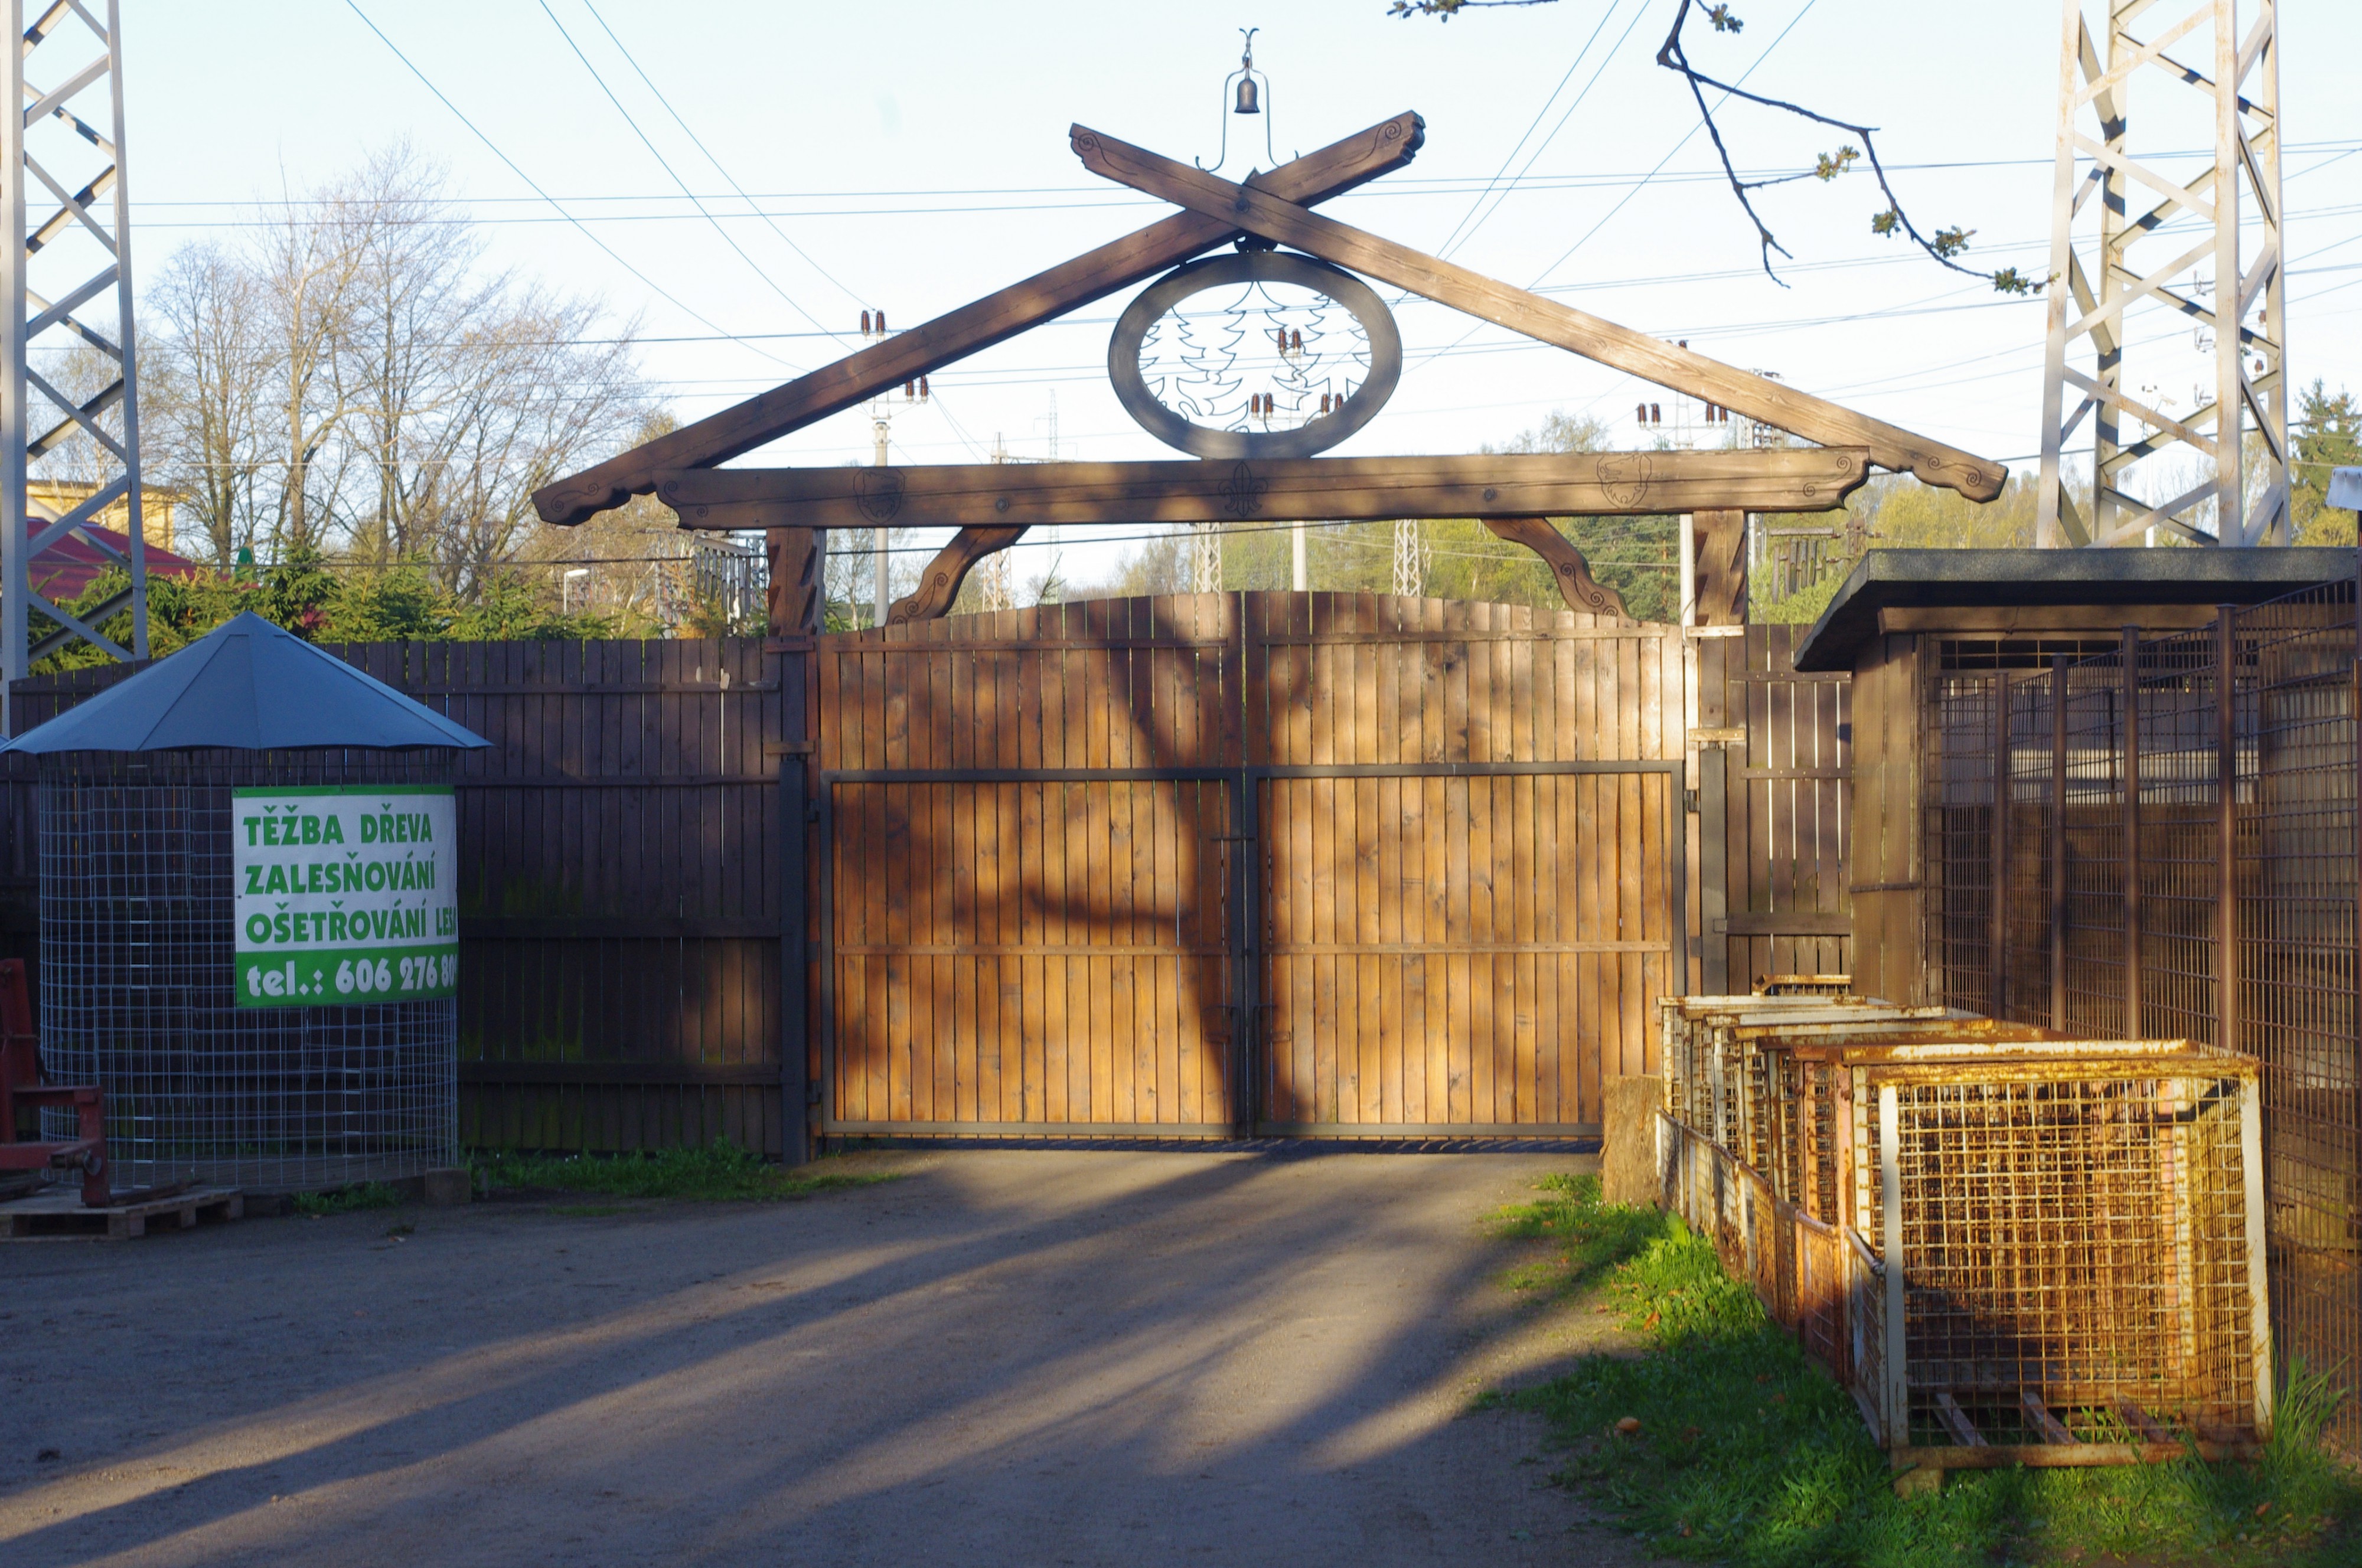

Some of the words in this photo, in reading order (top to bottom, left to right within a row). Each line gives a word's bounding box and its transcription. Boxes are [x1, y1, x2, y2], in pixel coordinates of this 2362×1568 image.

[243, 805, 344, 846] TĚŽBA
[360, 803, 432, 844] DŘEVA
[245, 850, 435, 894] ZALESŇOVÁNÍ
[246, 899, 426, 943] OŠETŘOVÁNÍ
[247, 961, 323, 997] tel.:
[335, 958, 392, 994] 606
[399, 955, 438, 990] 276
